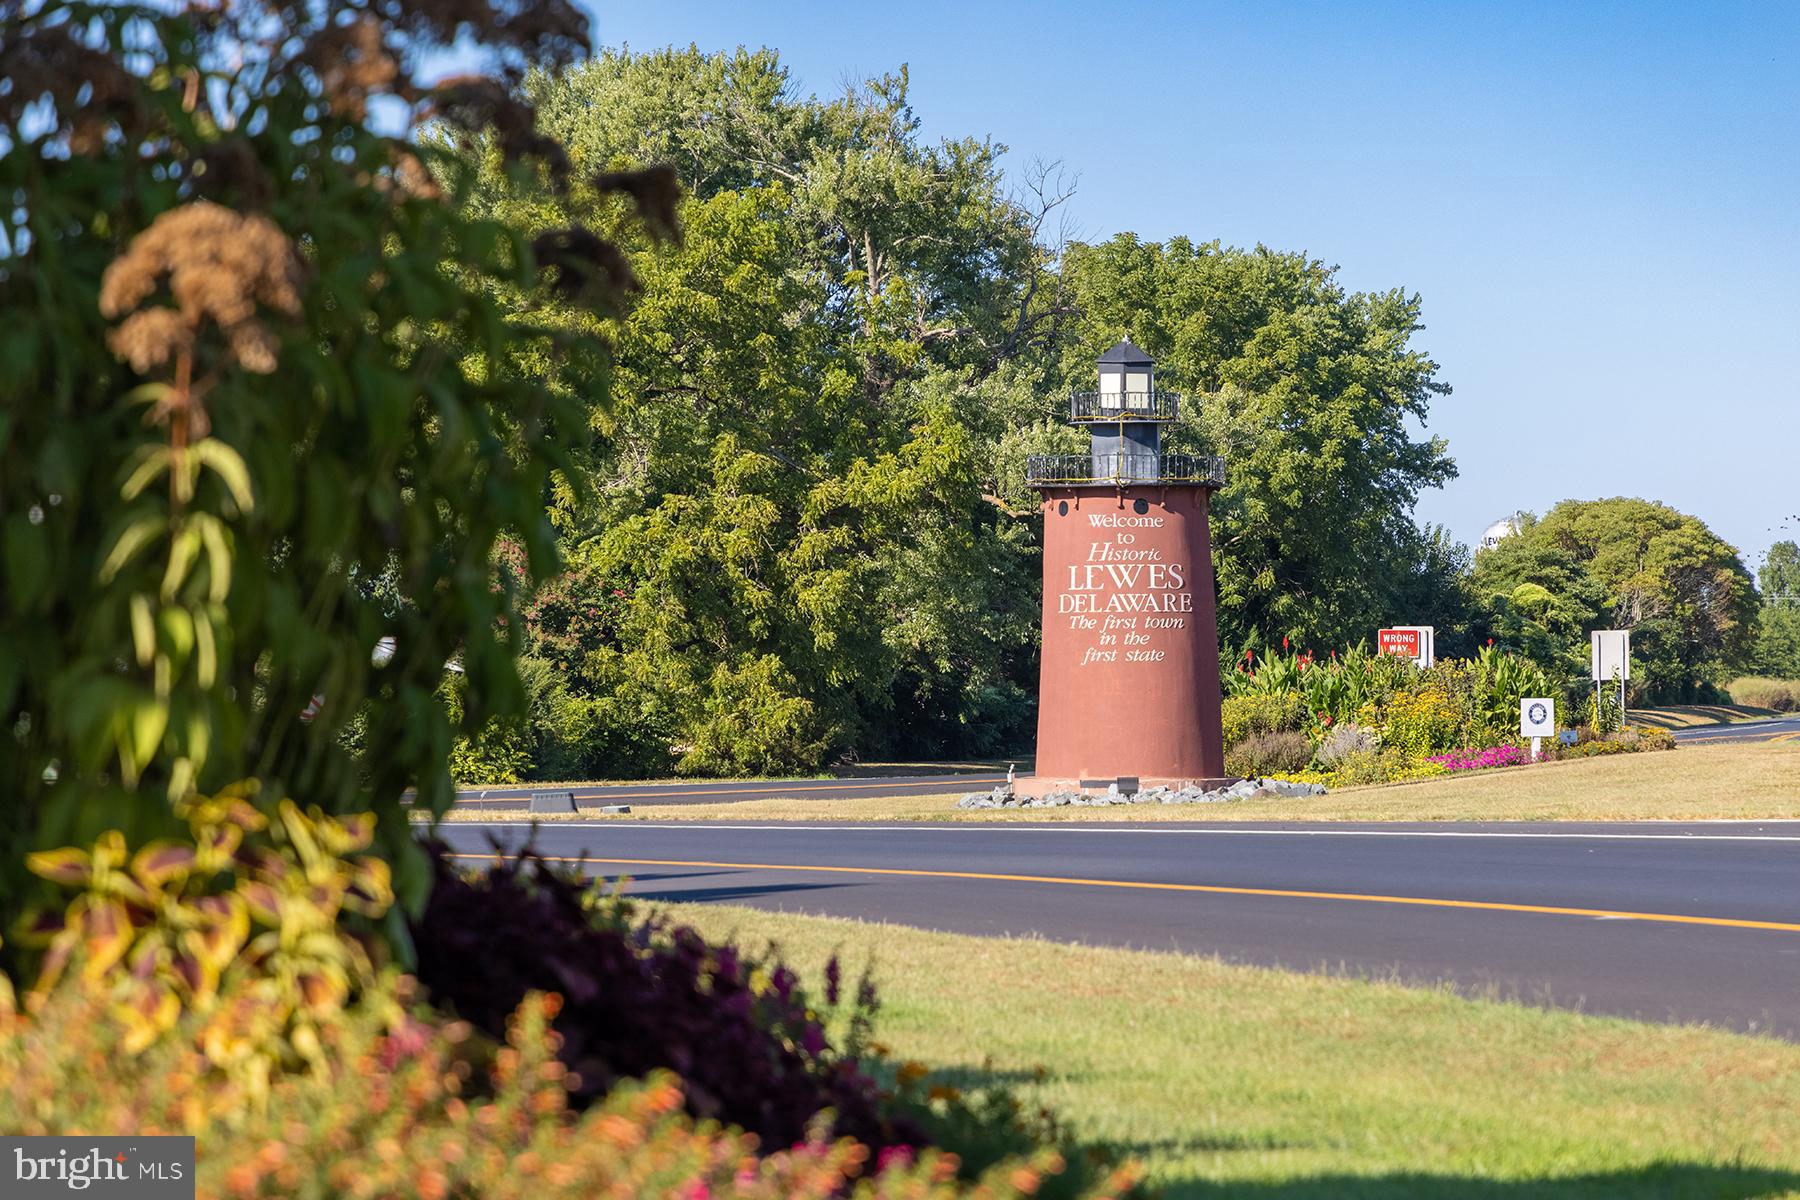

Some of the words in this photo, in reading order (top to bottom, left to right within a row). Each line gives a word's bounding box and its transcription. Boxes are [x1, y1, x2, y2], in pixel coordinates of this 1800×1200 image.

[1088, 513, 1164, 528] Welcome
[1117, 532, 1135, 545] to
[1086, 542, 1162, 562] Historic
[1068, 563, 1184, 590] LEWES
[1058, 593, 1193, 614] DELAWARE
[1069, 615, 1097, 630] The
[1099, 614, 1137, 633] first
[1144, 616, 1185, 630] town
[1099, 632, 1117, 646] in
[1123, 631, 1151, 646] the
[1383, 634, 1415, 643] WRONG
[1081, 647, 1117, 666] first
[1125, 649, 1165, 662] state
[1389, 645, 1408, 653] WAY
